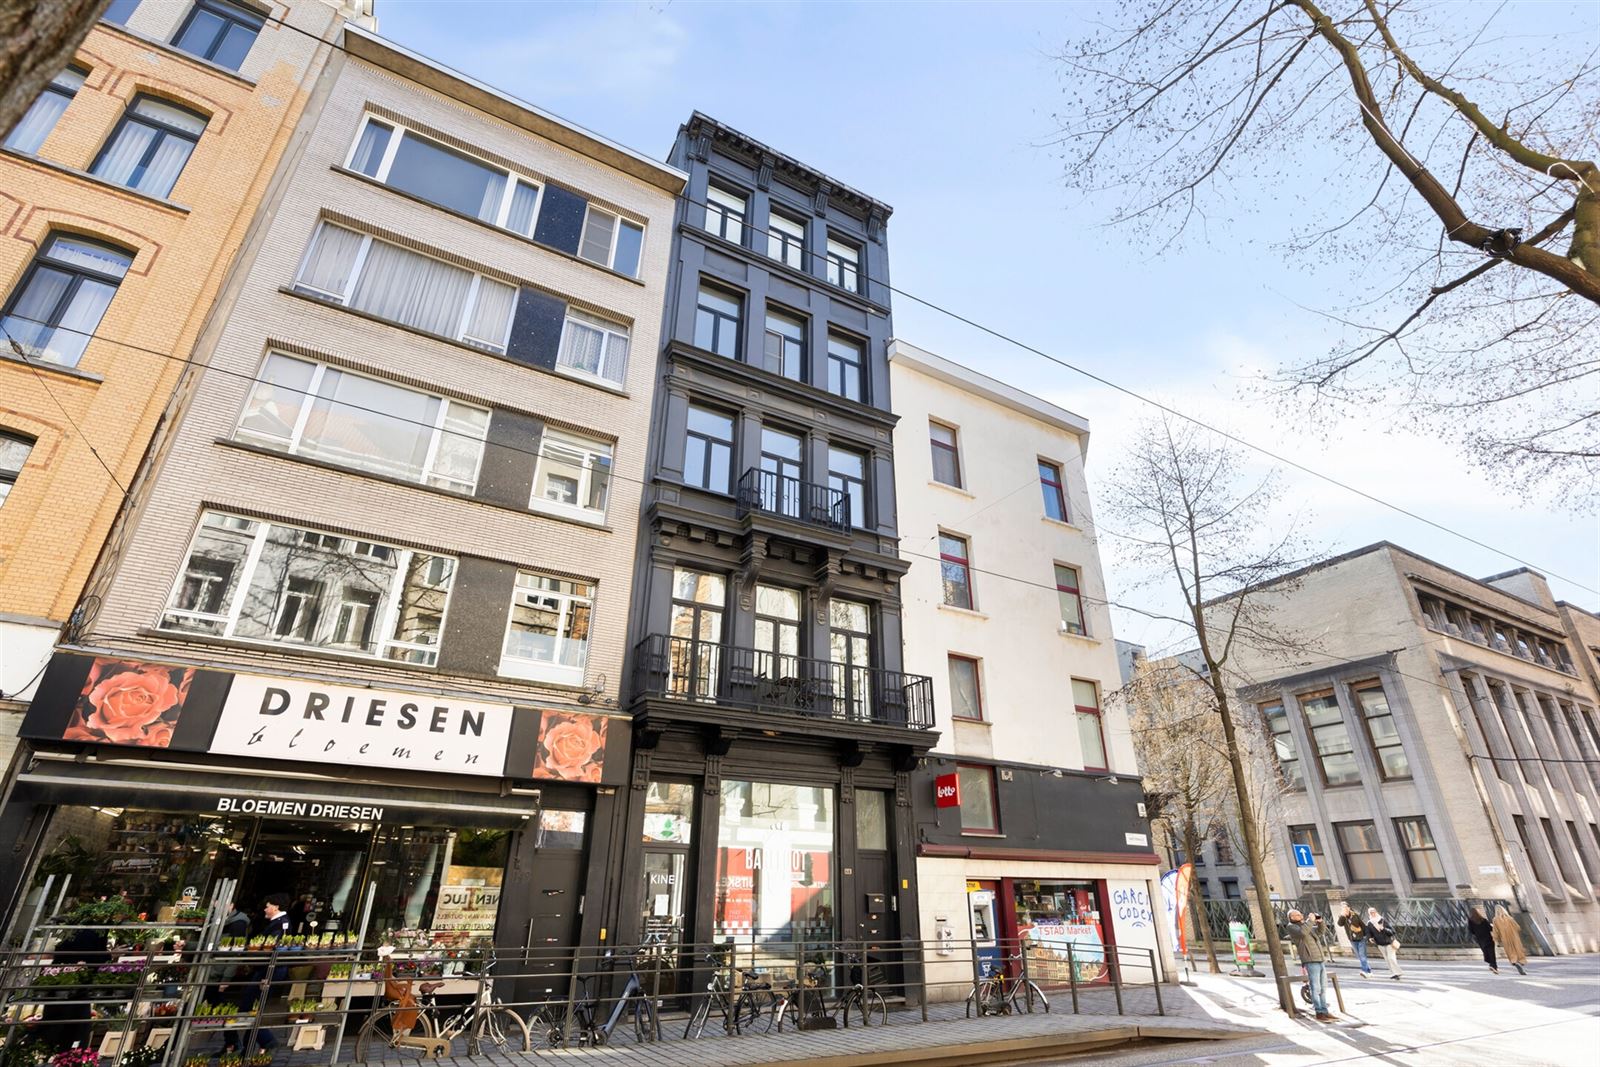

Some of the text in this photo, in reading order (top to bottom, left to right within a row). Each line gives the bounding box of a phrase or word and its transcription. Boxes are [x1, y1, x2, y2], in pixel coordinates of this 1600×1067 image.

[259, 687, 485, 737] DRIESEN
[247, 725, 479, 764] bloemen
[216, 798, 384, 821] BLOEMEN DRIESEN
[650, 875, 675, 885] KINE
